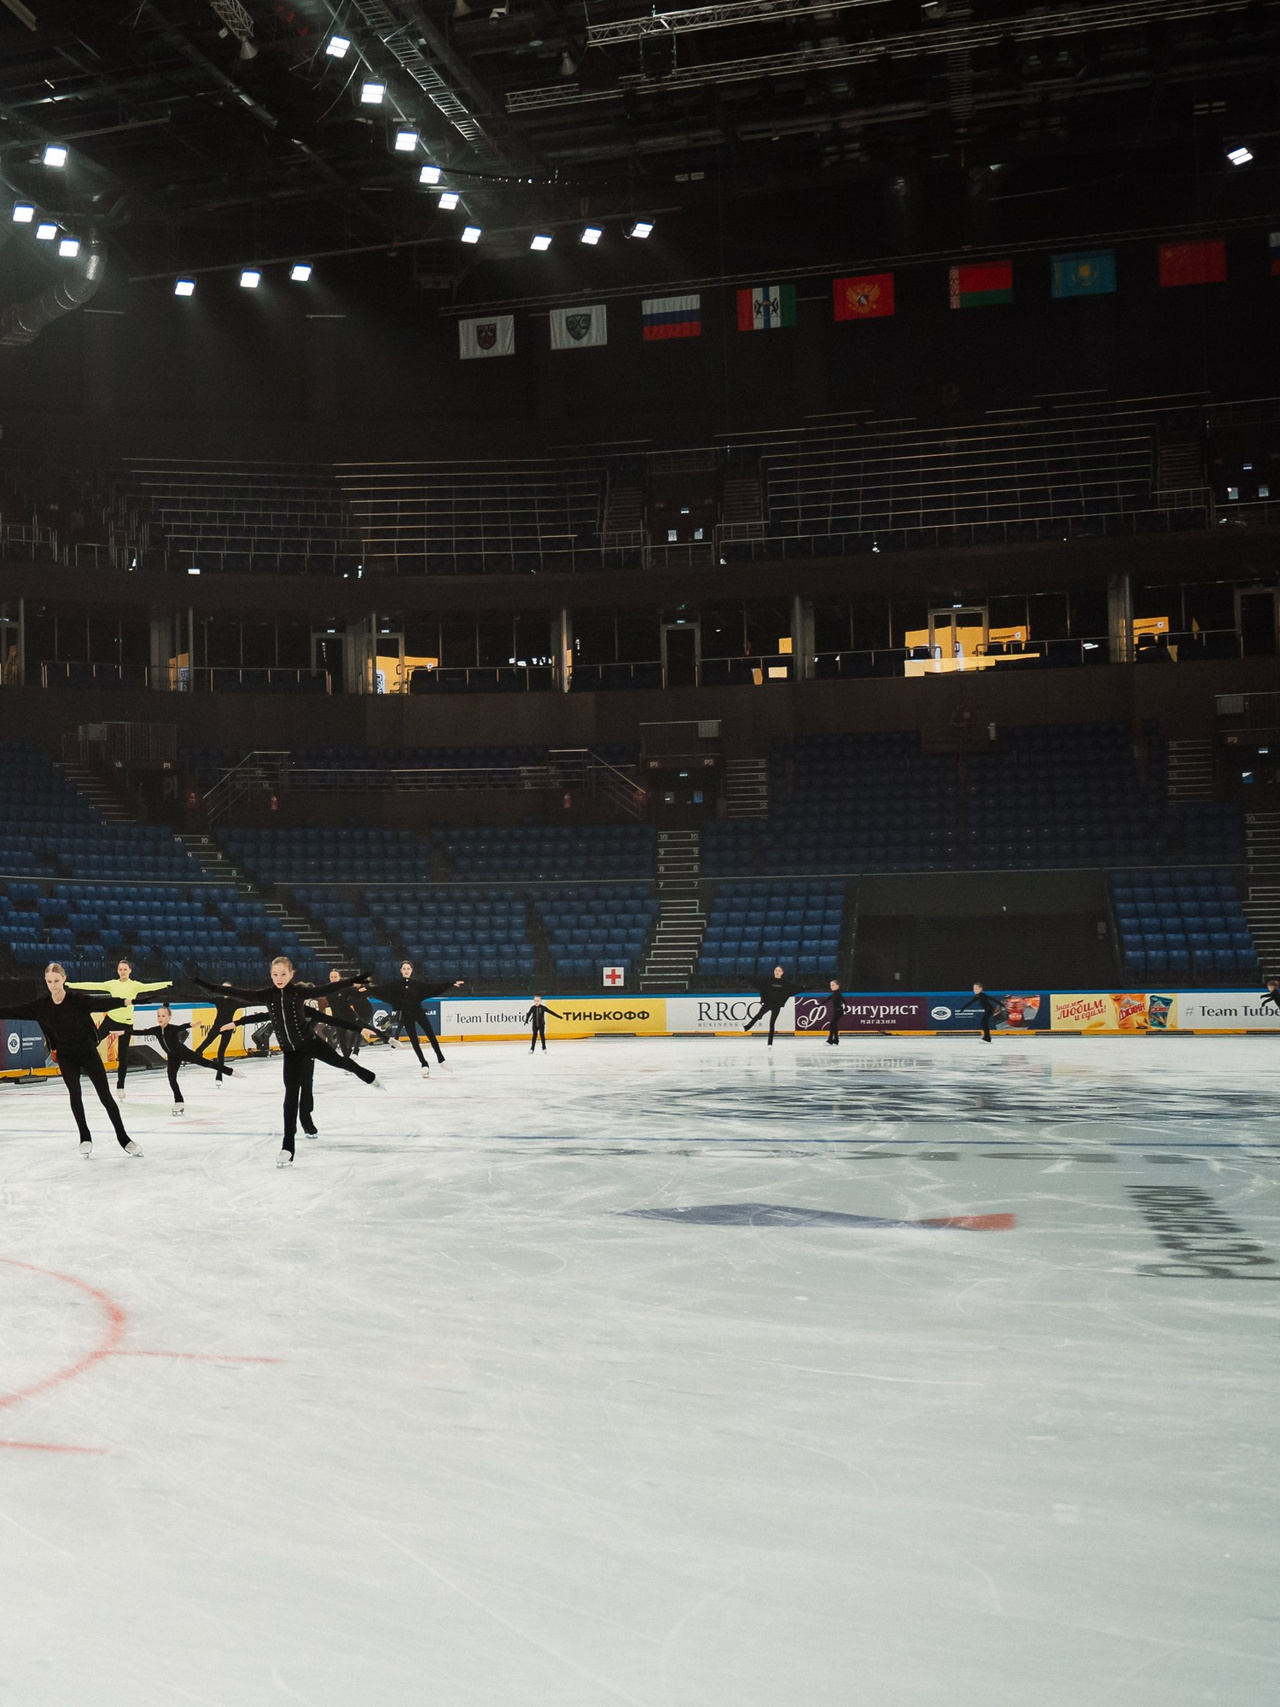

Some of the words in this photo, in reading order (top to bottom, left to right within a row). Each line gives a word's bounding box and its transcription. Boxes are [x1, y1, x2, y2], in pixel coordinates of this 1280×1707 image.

[563, 1010, 650, 1021] ТИНЬКОФФ
[697, 1002, 763, 1021] RRCC
[1057, 999, 1103, 1020] любим
[1198, 1006, 1238, 1017] Team
[455, 1013, 486, 1024] Team
[485, 1012, 532, 1023] Tutberi
